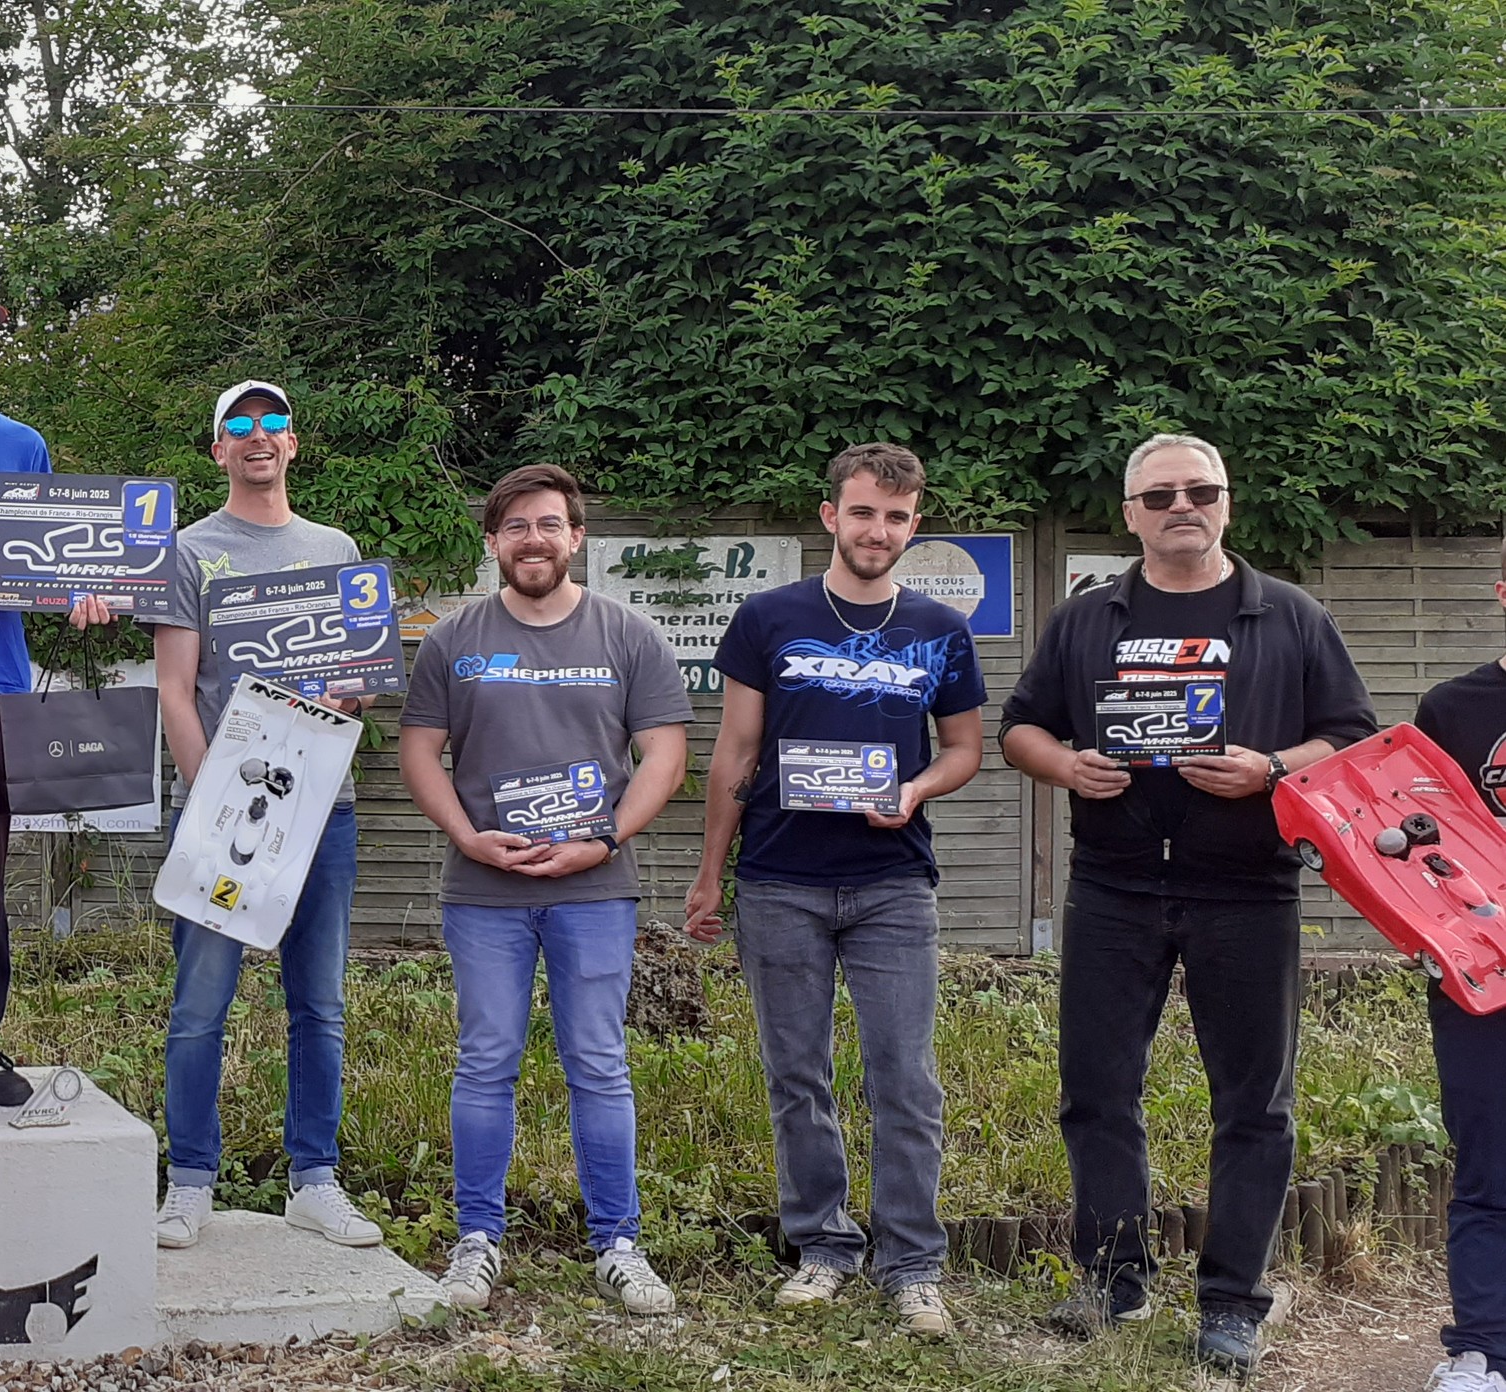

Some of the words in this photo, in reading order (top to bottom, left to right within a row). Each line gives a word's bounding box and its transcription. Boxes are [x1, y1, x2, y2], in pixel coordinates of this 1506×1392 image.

[49, 488, 69, 497] 6-7-8
[71, 488, 87, 499] juin
[89, 489, 109, 498] 2025
[75, 511, 113, 519] Ris-Orangis
[135, 490, 158, 526] 1
[265, 585, 286, 595] 6-7-8
[287, 582, 304, 594] juin
[305, 579, 325, 590] 2025
[349, 573, 378, 609] 3
[916, 588, 978, 596] VEILLANCE
[216, 609, 258, 621] Championnat
[267, 605, 289, 614] France
[294, 600, 331, 611] Ris-Orangis
[272, 673, 308, 684] ACING
[313, 669, 340, 678] TEAM
[488, 667, 612, 680] SHEPHERD
[779, 656, 928, 686] XRAY
[824, 680, 882, 690] RACING
[1194, 688, 1215, 711] 7
[78, 742, 104, 752] SAGA
[868, 750, 886, 768] 6
[578, 766, 595, 788] 5
[215, 881, 238, 902] 2
